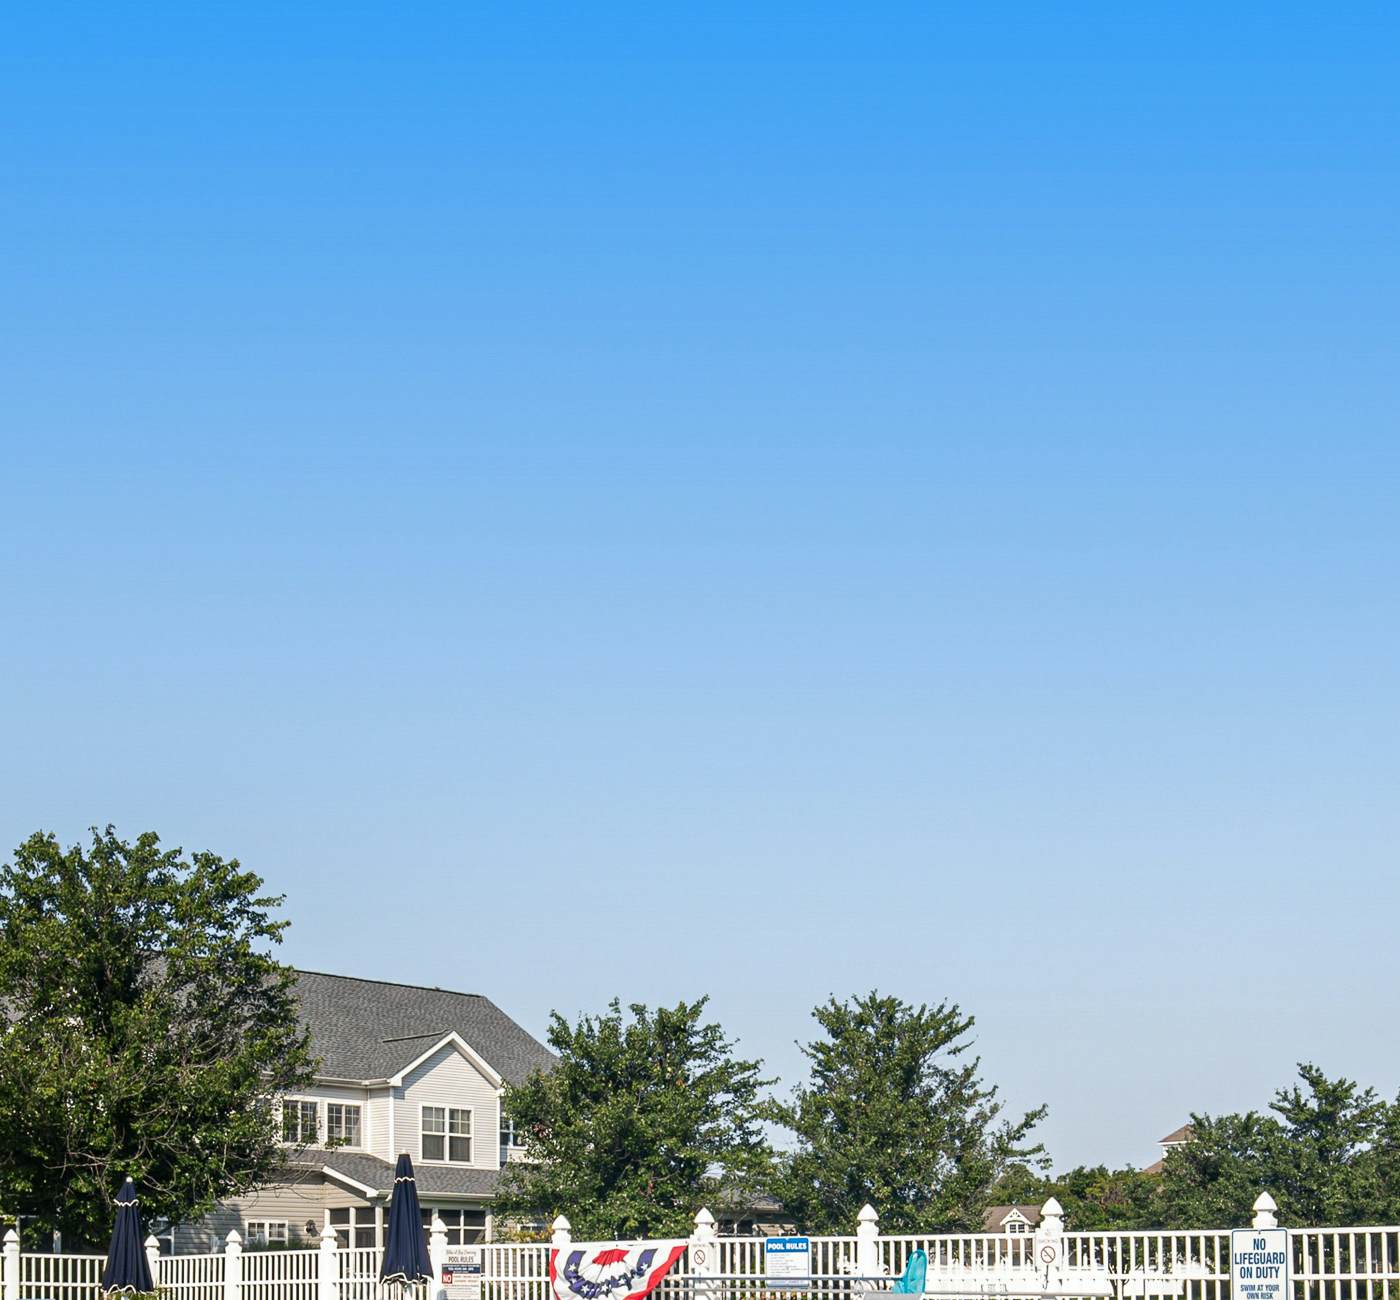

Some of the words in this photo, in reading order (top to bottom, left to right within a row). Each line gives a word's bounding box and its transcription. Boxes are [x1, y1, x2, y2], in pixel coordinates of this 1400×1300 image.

[768, 1242, 785, 1250] POOL
[786, 1242, 807, 1250] RULES
[1253, 1238, 1266, 1250] NO
[1234, 1252, 1285, 1265] LIFEGUARD
[1240, 1266, 1253, 1279] ON
[1255, 1266, 1280, 1279] DUTY
[442, 1273, 452, 1283] NO
[1240, 1284, 1256, 1292] SWIM
[1257, 1284, 1264, 1292] AT
[1265, 1284, 1280, 1292] YOUR
[1246, 1292, 1259, 1300] OWN
[1260, 1292, 1274, 1300] RISK
